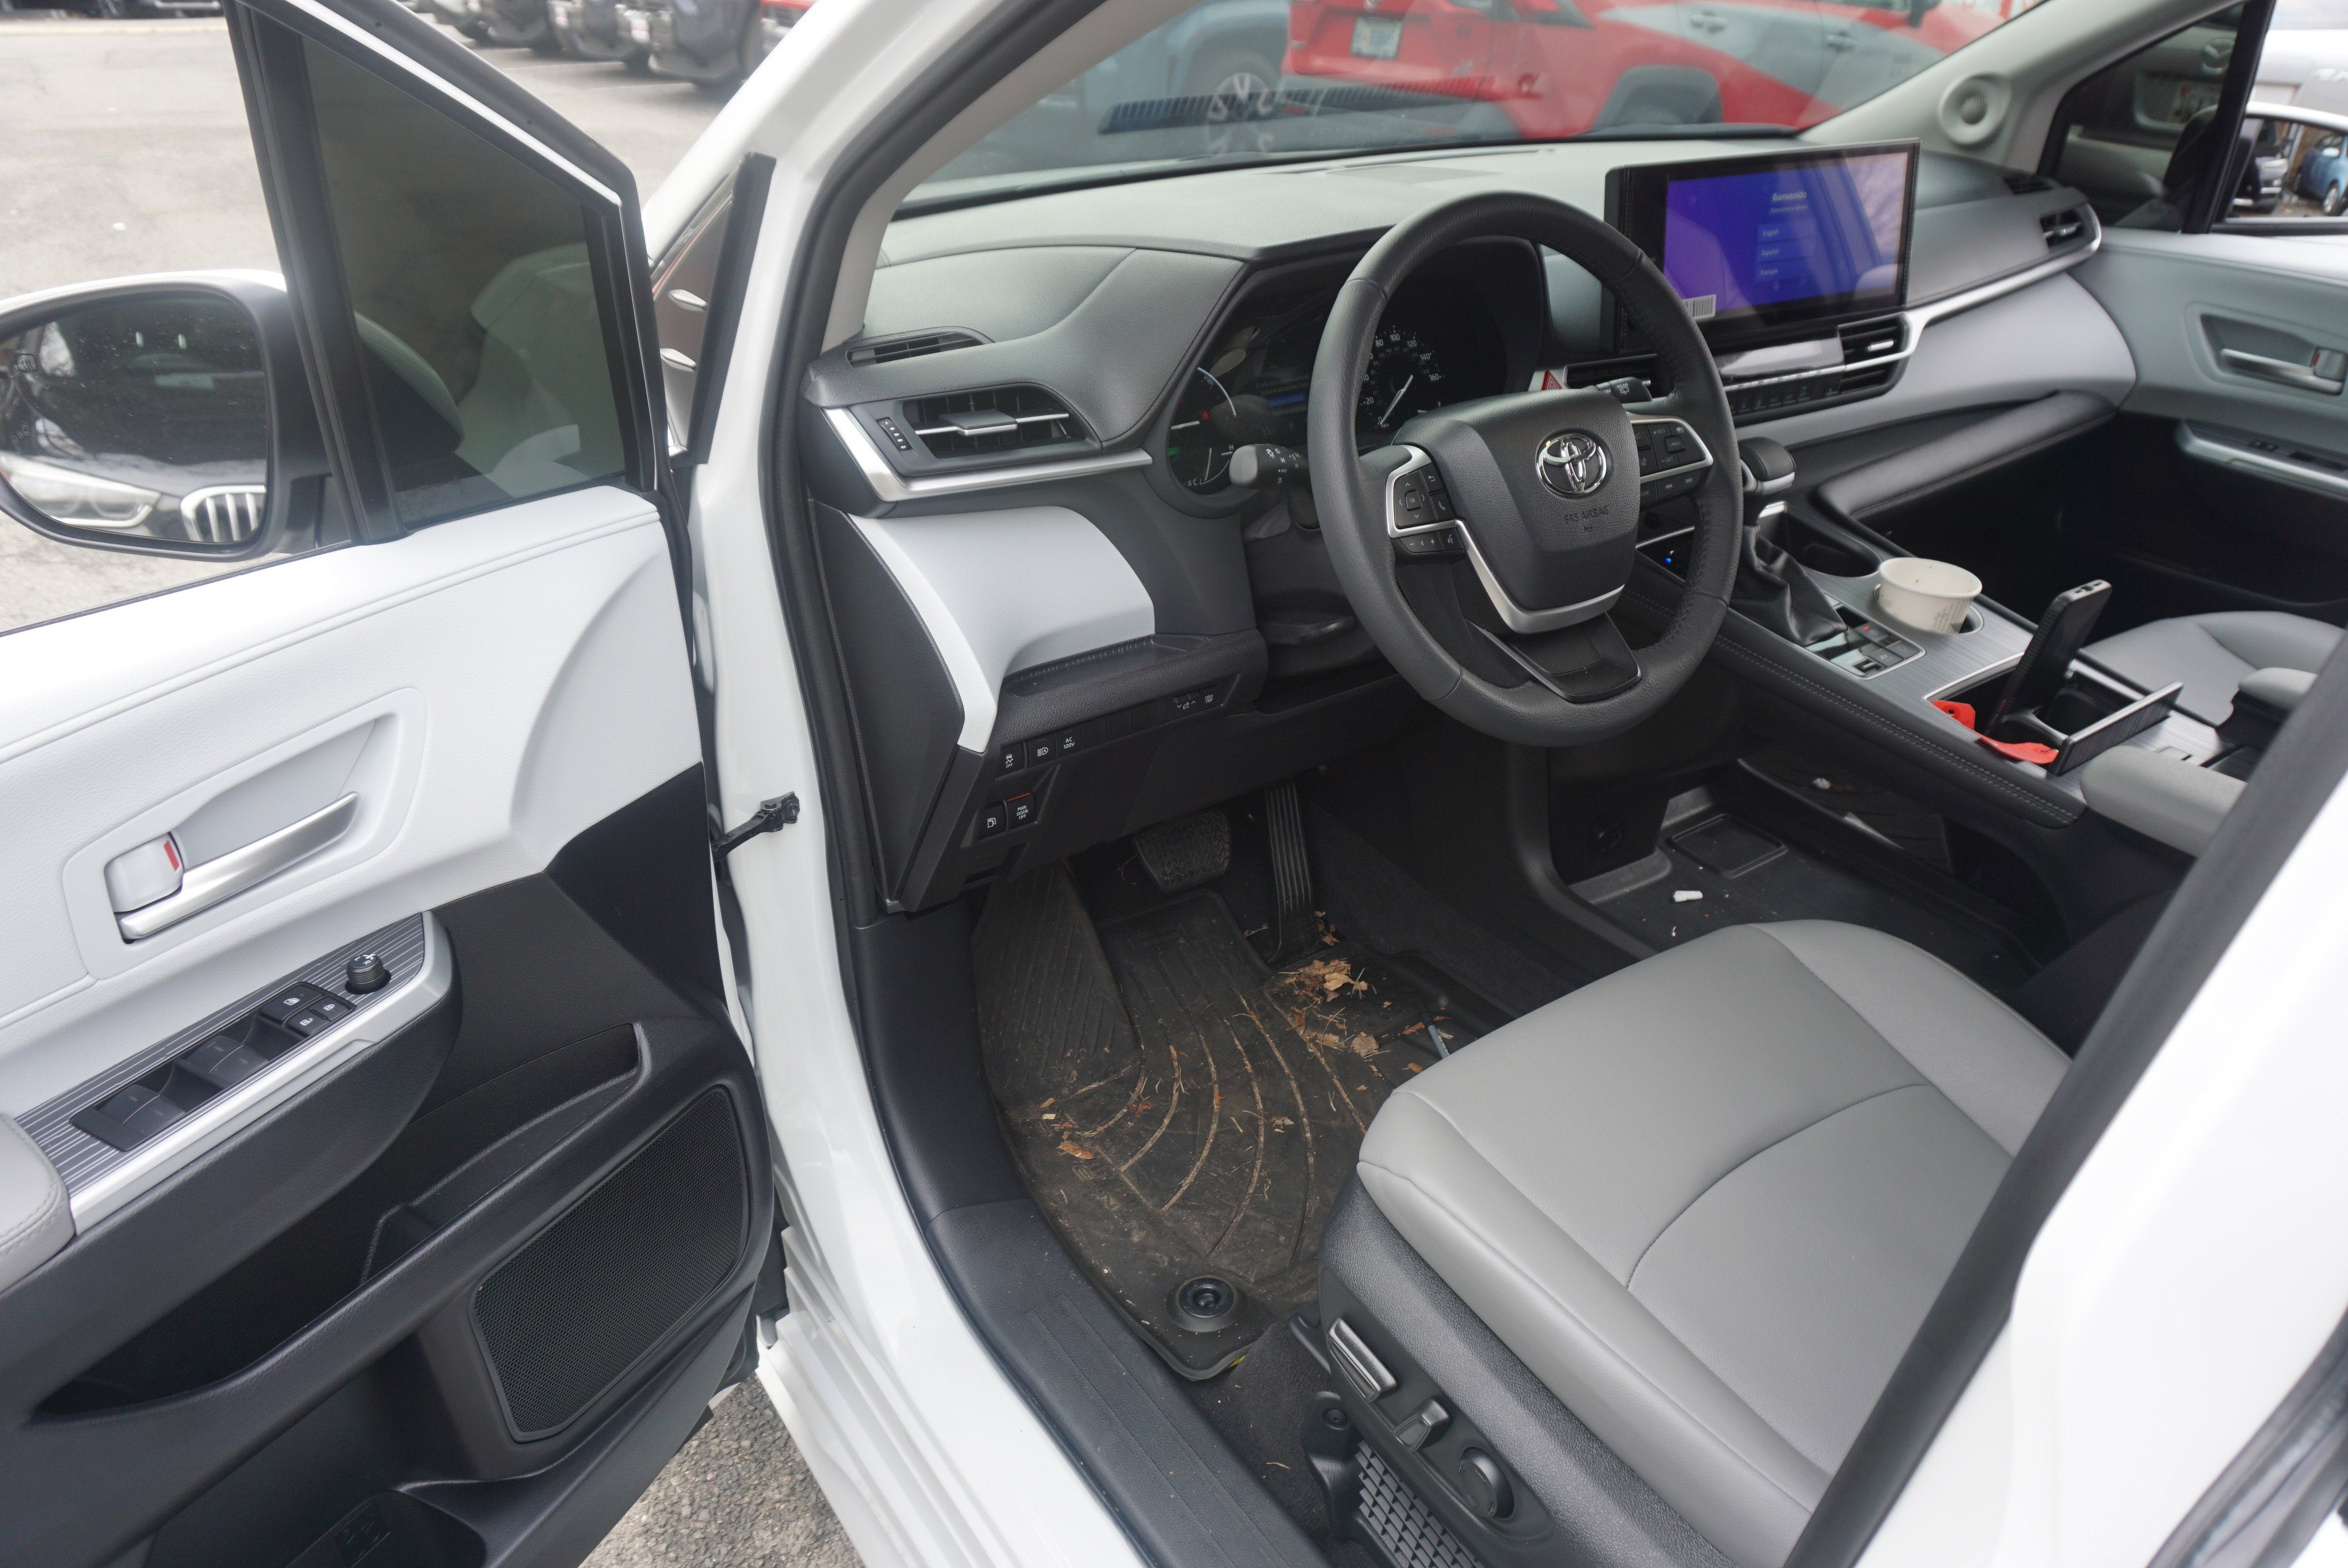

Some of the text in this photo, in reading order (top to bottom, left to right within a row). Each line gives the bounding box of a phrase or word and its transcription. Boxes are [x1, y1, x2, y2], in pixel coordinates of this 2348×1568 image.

[1773, 190, 1807, 201] Bienvenido
[1389, 333, 1400, 342] 100
[1419, 353, 1430, 361] 140
[1203, 375, 1214, 386] PWR
[1429, 373, 1439, 381] 160
[1366, 396, 1374, 405] 20
[1564, 506, 1608, 524] SRS AIRBAG
